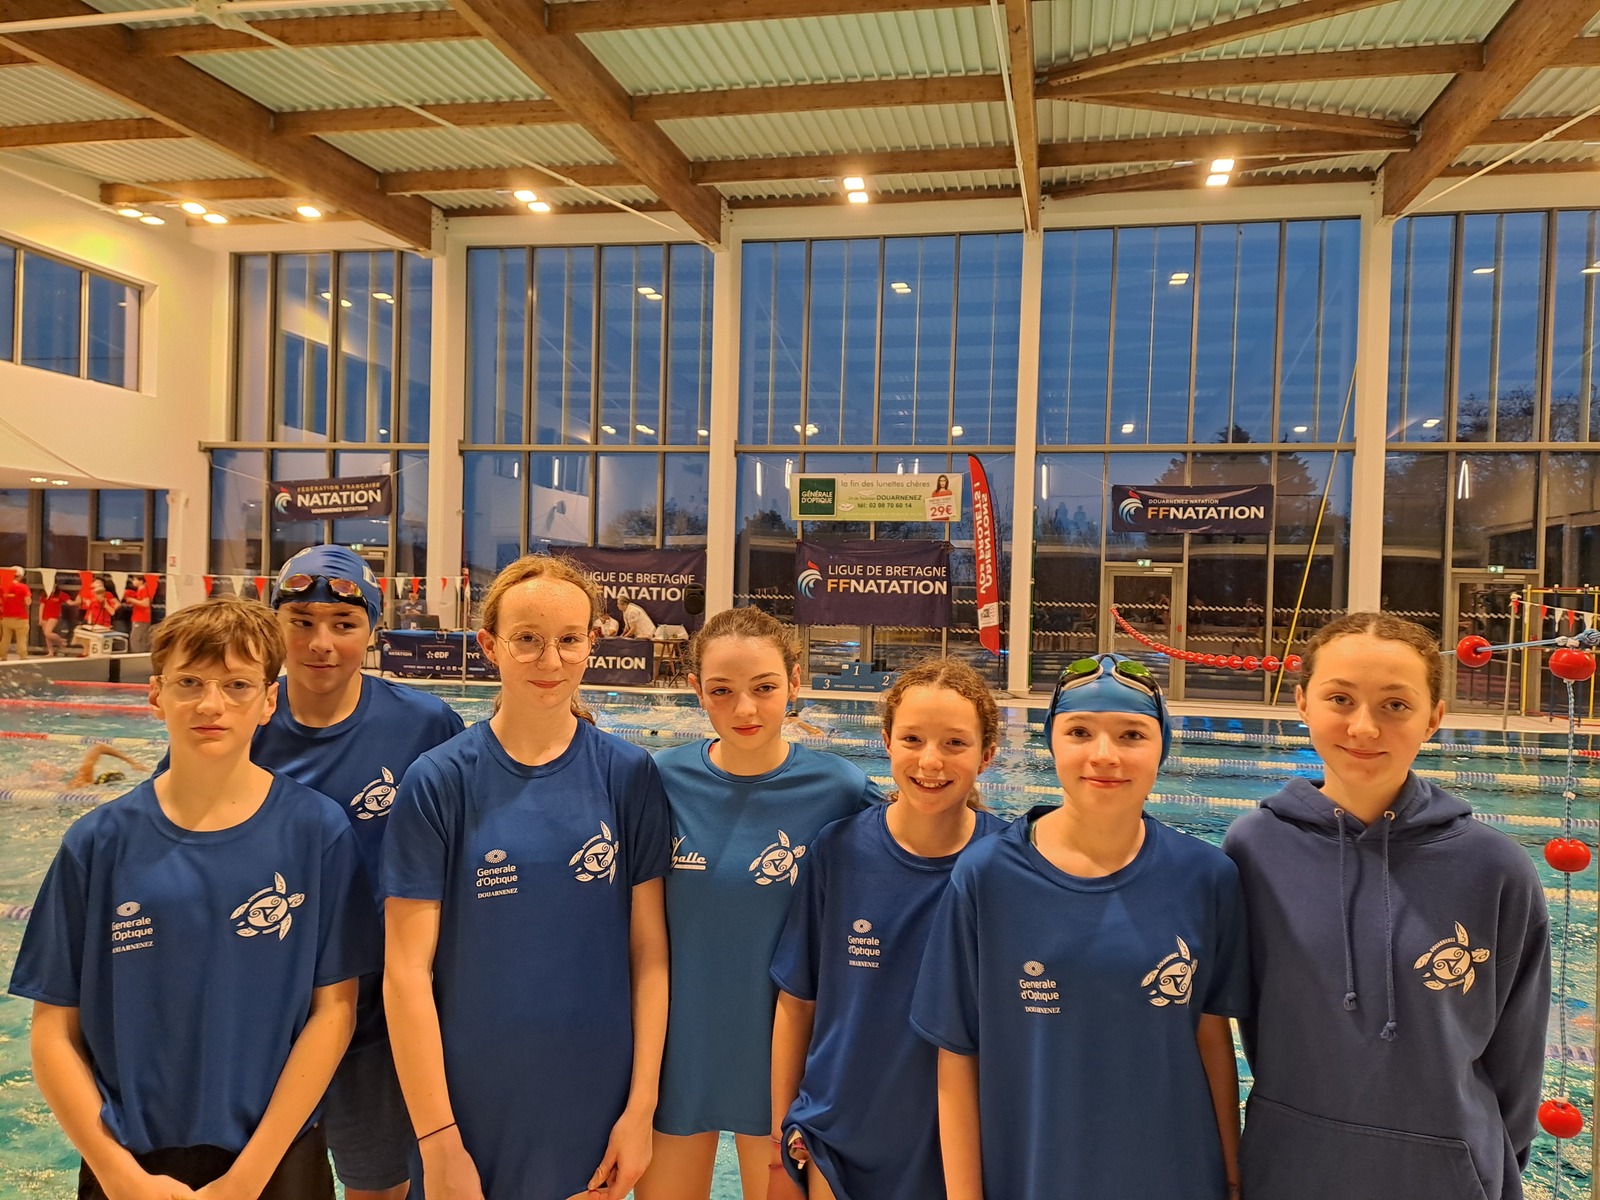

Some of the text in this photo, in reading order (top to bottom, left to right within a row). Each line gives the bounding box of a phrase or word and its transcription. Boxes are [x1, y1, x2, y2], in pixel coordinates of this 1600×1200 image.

[841, 479, 930, 488] la fin des lunettes chères
[297, 489, 381, 507] NATATION
[801, 489, 833, 498] GÉNÉRALE
[801, 497, 833, 505] D'OPTIQUE
[930, 505, 953, 517] 29€
[1147, 505, 1265, 520] FFNATATION
[828, 564, 947, 577] LIGUE DE BRETAGNE
[619, 573, 633, 583] DE
[635, 574, 695, 585] BRETAGNE
[827, 578, 948, 595] FFNATATION
[853, 665, 860, 676] 1
[822, 678, 831, 690] 3
[881, 675, 890, 686] 2
[477, 863, 517, 877] Generale
[476, 874, 518, 887] d'Optique
[477, 888, 518, 899] DOUARNENEZ
[847, 935, 880, 946] Generale
[1019, 979, 1057, 989] Generale
